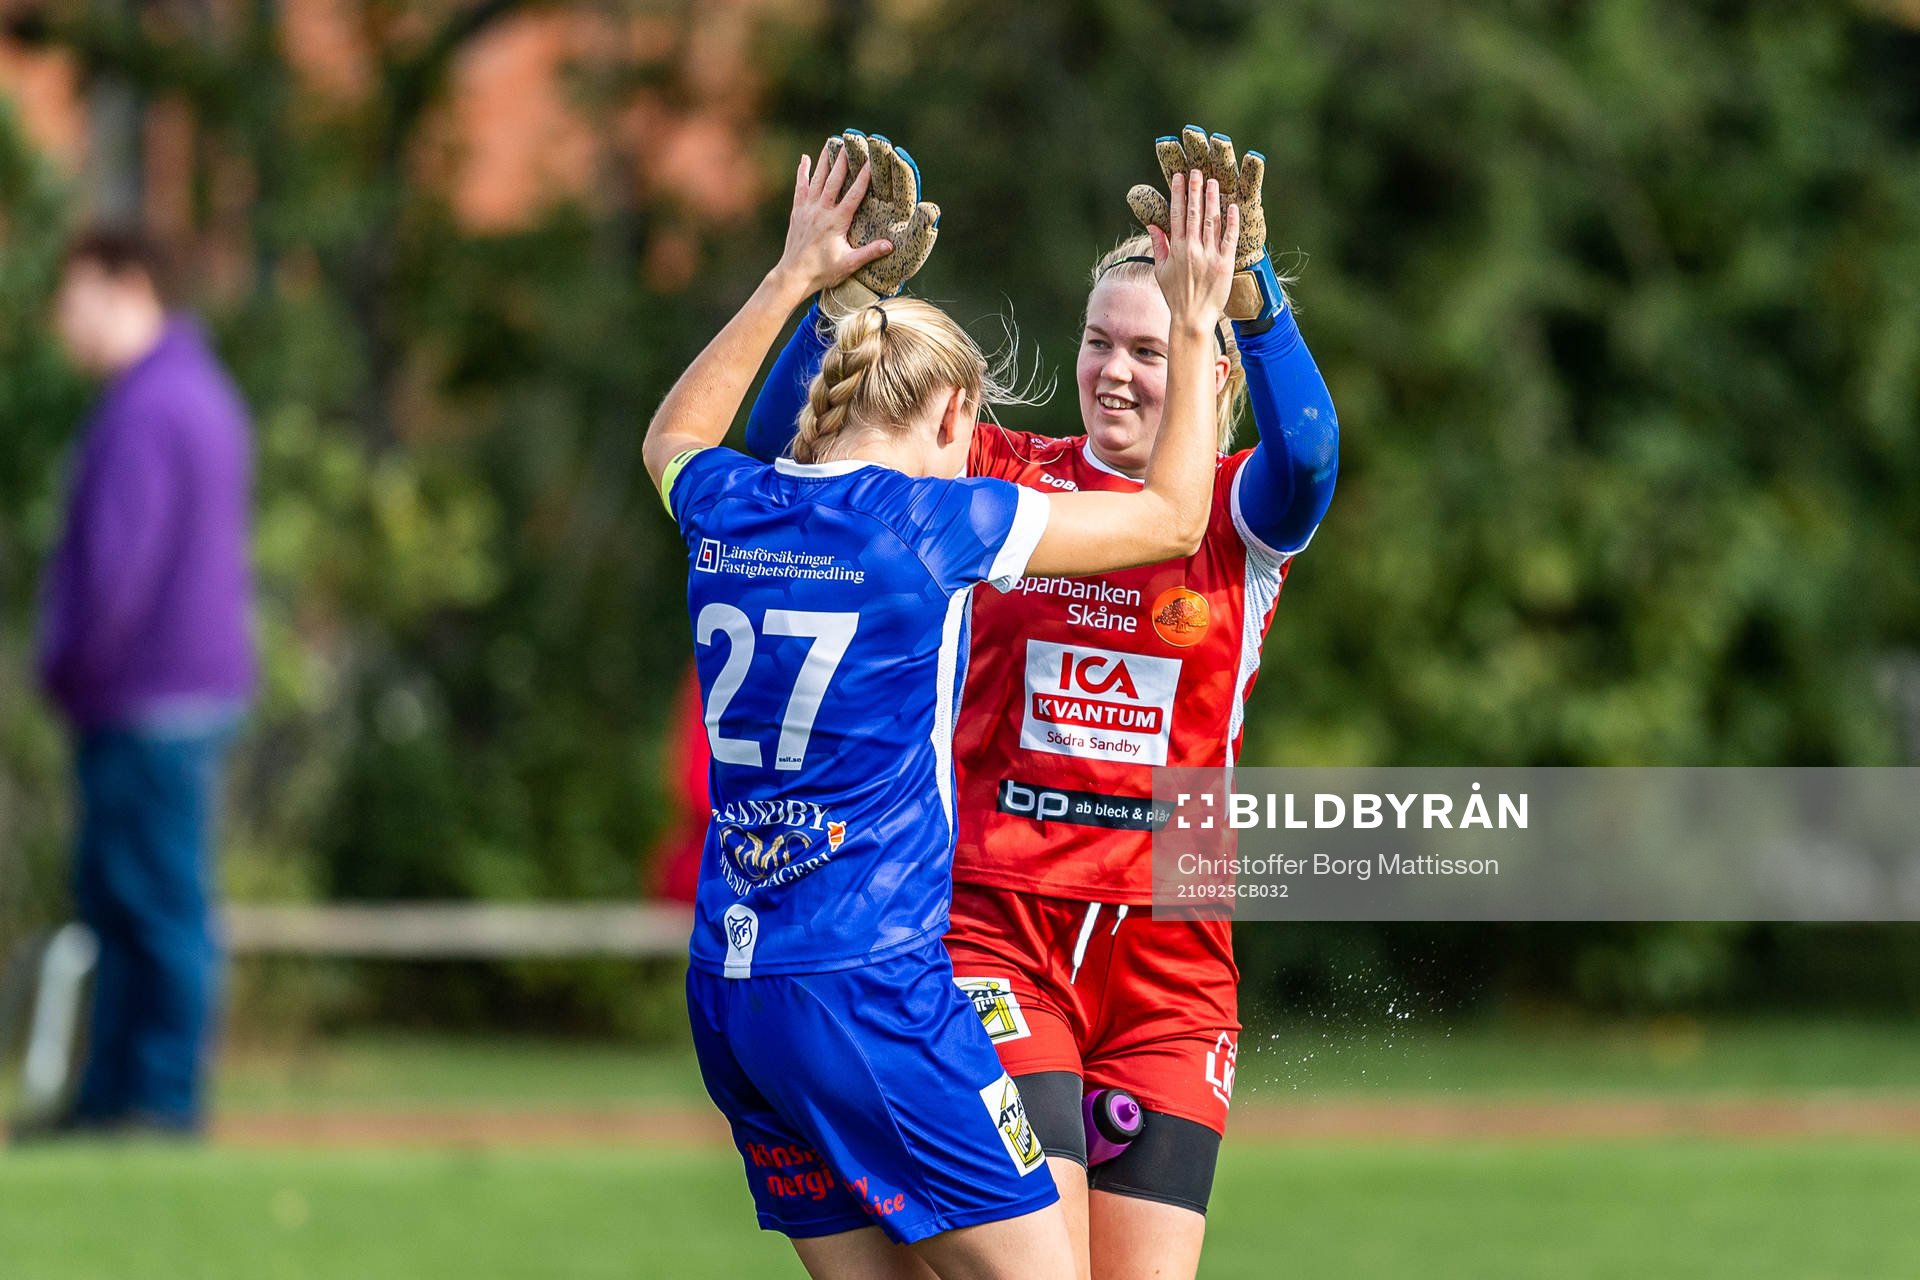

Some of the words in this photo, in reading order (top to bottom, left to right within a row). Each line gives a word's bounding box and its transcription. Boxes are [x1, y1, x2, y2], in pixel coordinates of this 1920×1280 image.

[719, 559, 865, 584] Fastighetsförmedling
[722, 544, 835, 568] Länsförsäkringar
[1066, 603, 1137, 633] Skåne
[696, 602, 860, 771] 27
[1059, 651, 1139, 700] ICA
[1038, 698, 1156, 729] KVANTUM
[1046, 730, 1085, 747] Södra
[1089, 736, 1141, 756] Sandby
[1005, 780, 1069, 821] bp
[1075, 801, 1092, 814] ab
[1095, 803, 1129, 819] bleck
[1132, 807, 1143, 820] &
[1206, 1051, 1235, 1099] LK
[767, 1167, 836, 1201] nergi
